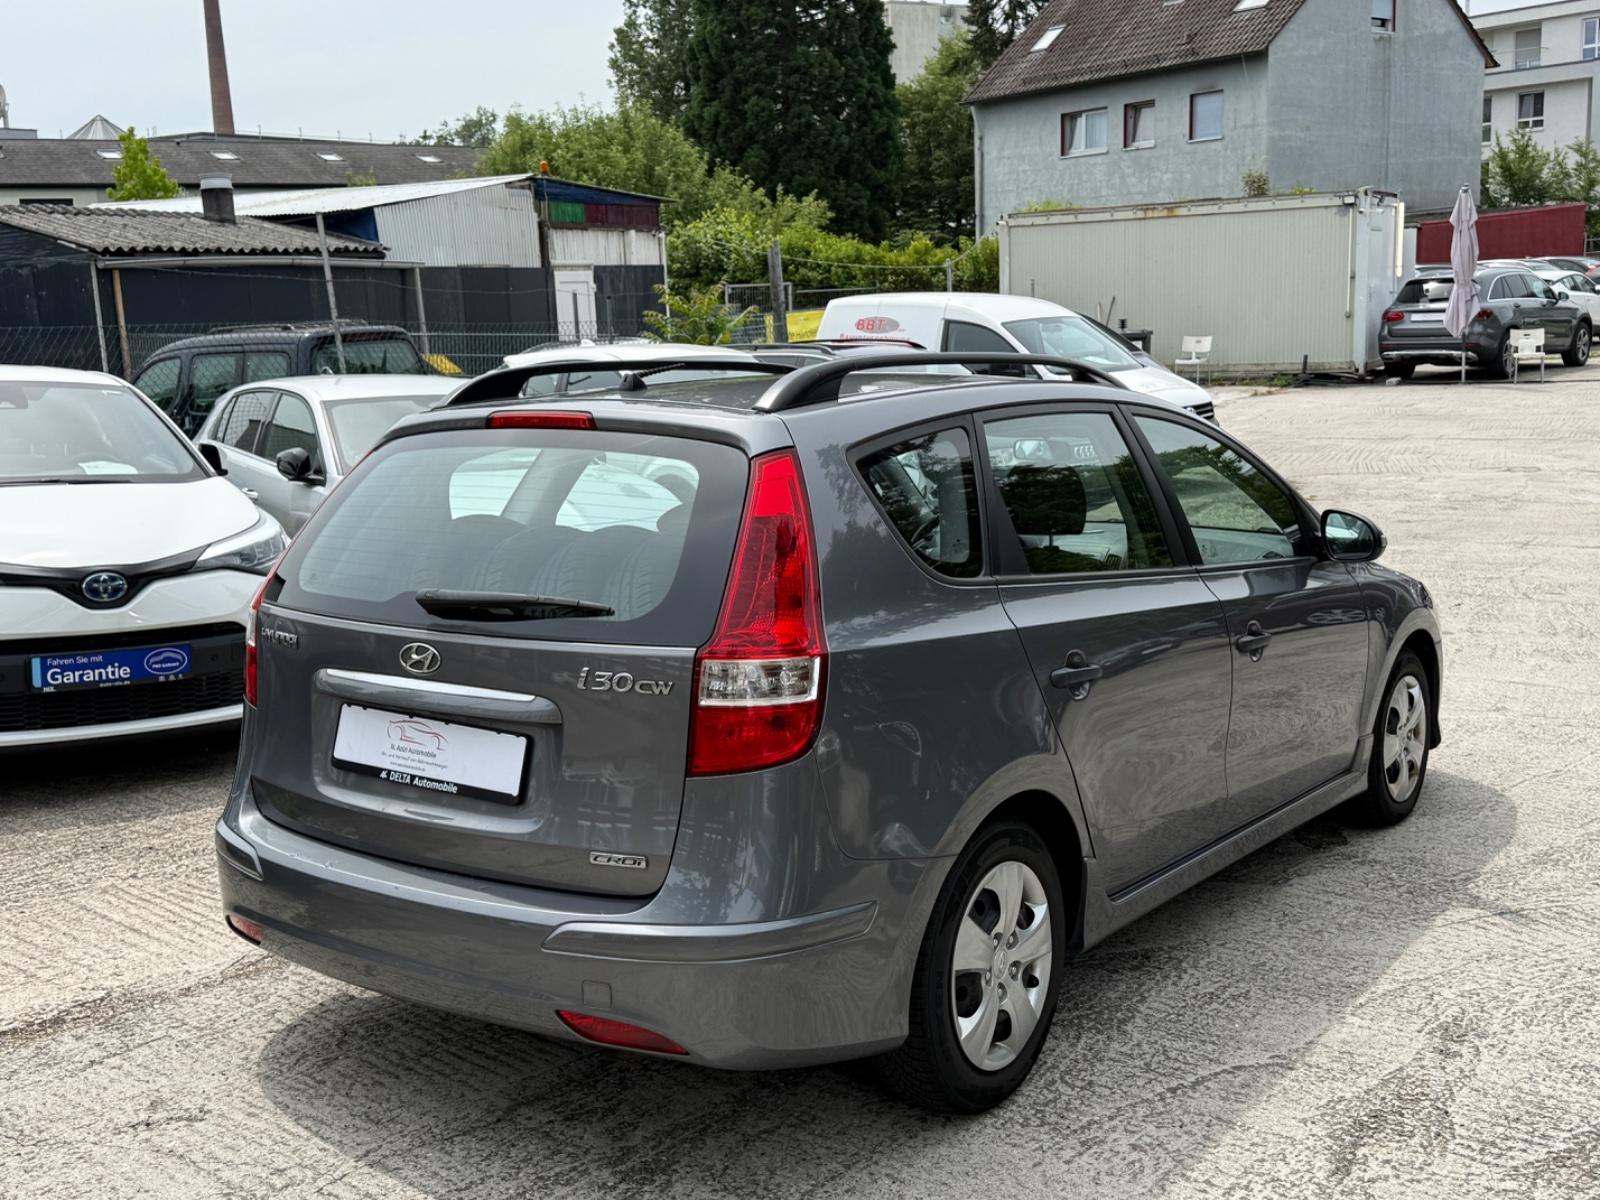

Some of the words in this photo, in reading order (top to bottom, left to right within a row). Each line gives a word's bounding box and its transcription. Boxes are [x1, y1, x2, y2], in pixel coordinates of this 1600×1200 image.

[47, 657, 75, 666] Fahren
[76, 655, 89, 664] Sie
[91, 655, 103, 663] mit
[47, 662, 131, 684] Garantie
[390, 772, 410, 784] DELTA
[413, 777, 458, 793] Automobile
